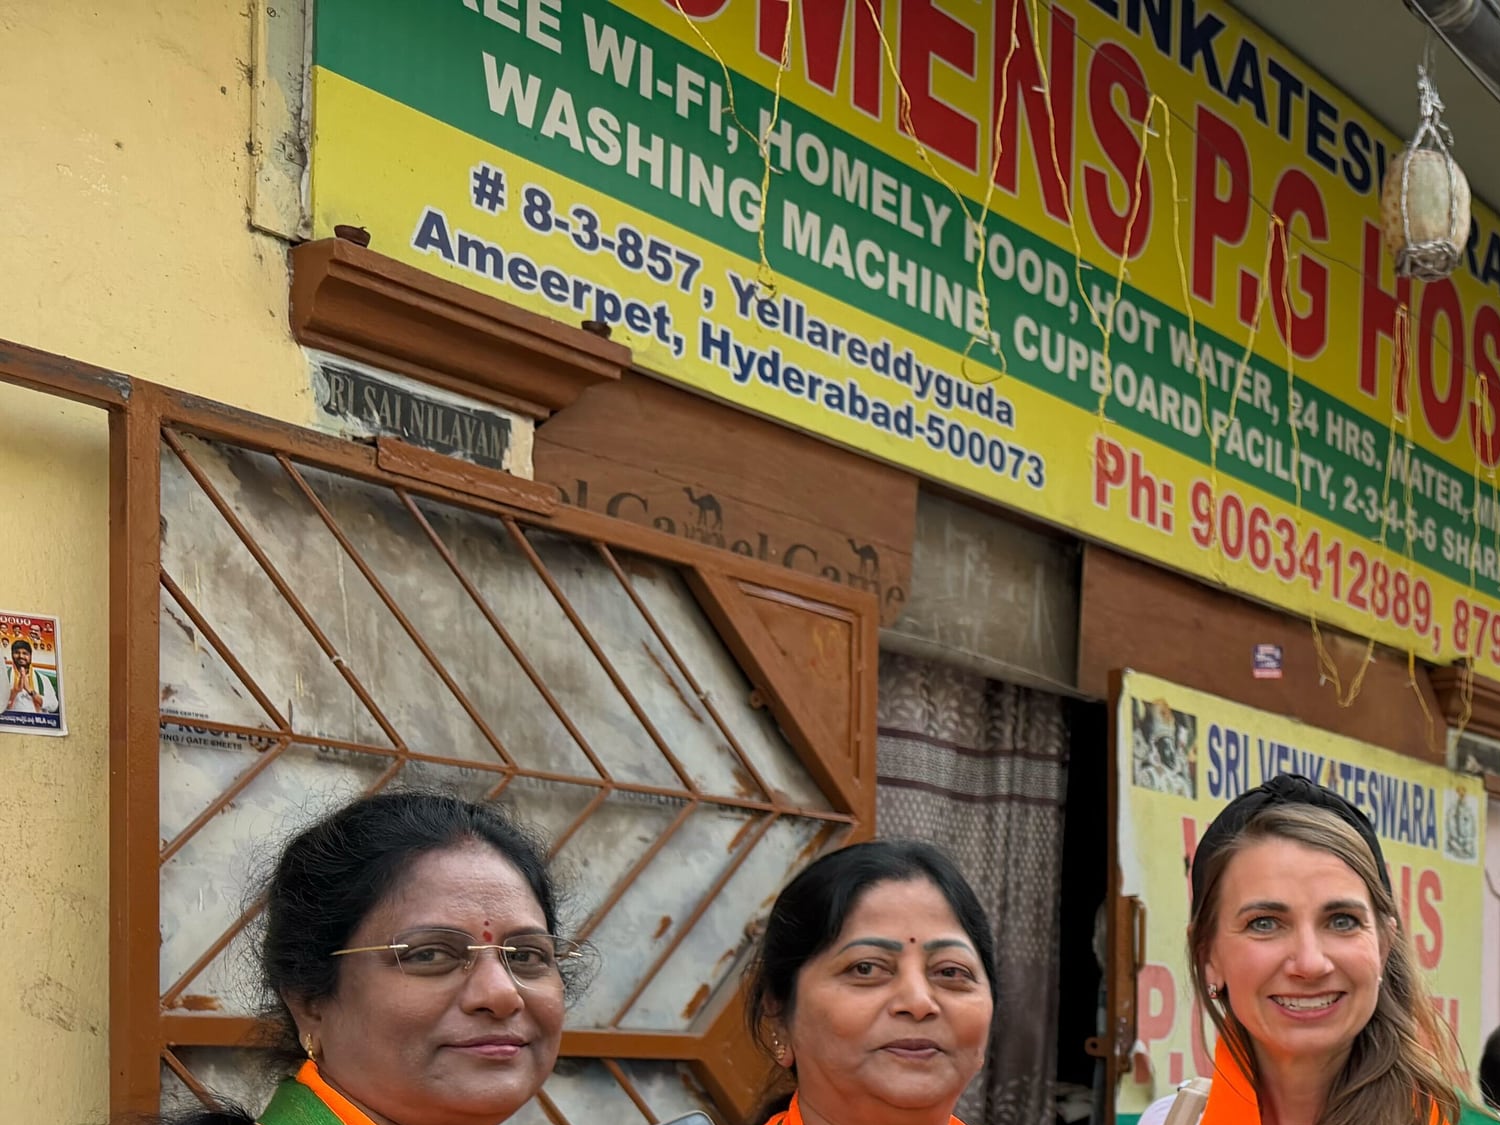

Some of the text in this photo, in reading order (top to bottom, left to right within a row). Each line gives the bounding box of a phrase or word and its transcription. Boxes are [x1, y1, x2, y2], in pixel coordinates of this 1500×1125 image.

[463, 0, 562, 54] EE
[582, 13, 739, 154] WI-FI,
[759, 108, 952, 247] HOMELY
[964, 216, 1079, 325] FOOD,
[1091, 284, 1160, 353] HOT
[1169, 325, 1280, 426] WATER,
[1288, 390, 1319, 437] 24
[1325, 409, 1382, 472] HRS.
[1390, 446, 1472, 523] WATER,
[472, 165, 506, 212] #
[729, 273, 1014, 427] Yellareddyguda
[482, 51, 763, 233] WASHING
[782, 198, 1000, 355] MACHINE,
[1013, 315, 1202, 438] CUPBOARD
[1211, 406, 1337, 511] FACILITY,
[1341, 475, 1438, 551] 2-3-4-5-6
[660, 0, 1153, 259] ENS
[1192, 104, 1330, 360] P.G
[363, 384, 402, 428] SAI
[412, 209, 1046, 488] Ameerpet, Hyderabad-500073
[1093, 436, 1174, 533] Ph:
[1188, 481, 1441, 654] 9063412889,
[1207, 723, 1250, 801] SRI
